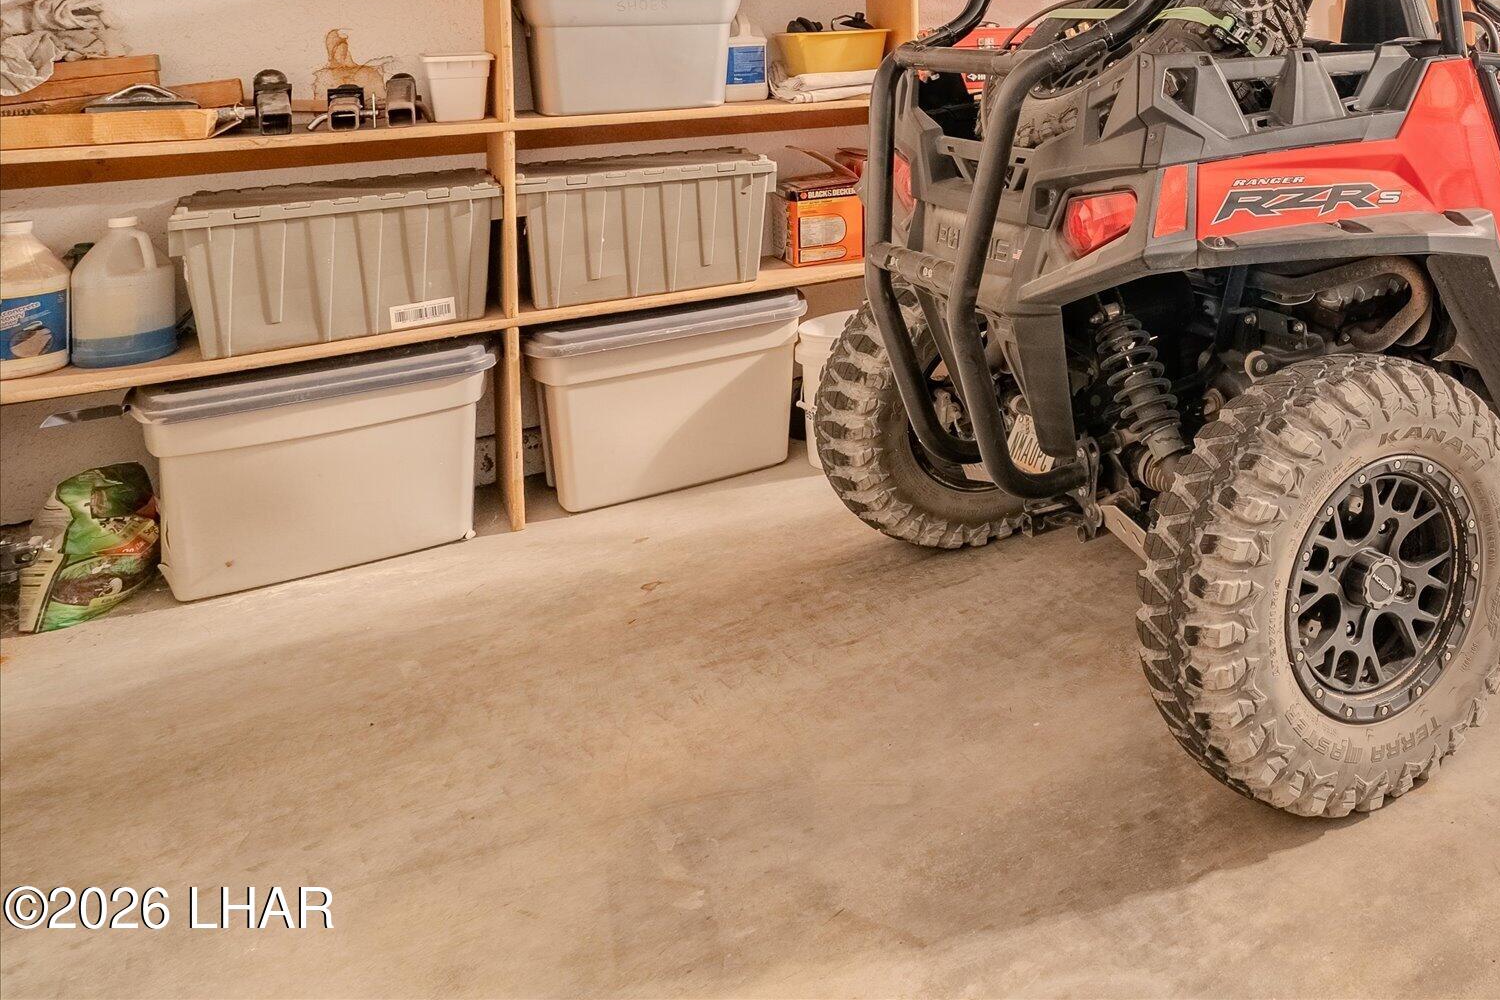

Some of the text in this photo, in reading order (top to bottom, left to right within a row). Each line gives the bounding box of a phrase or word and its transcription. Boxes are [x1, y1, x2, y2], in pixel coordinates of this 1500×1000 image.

[1232, 176, 1306, 187] RANGER
[1378, 426, 1485, 472] KANATI
[1371, 716, 1442, 763] TERRA
